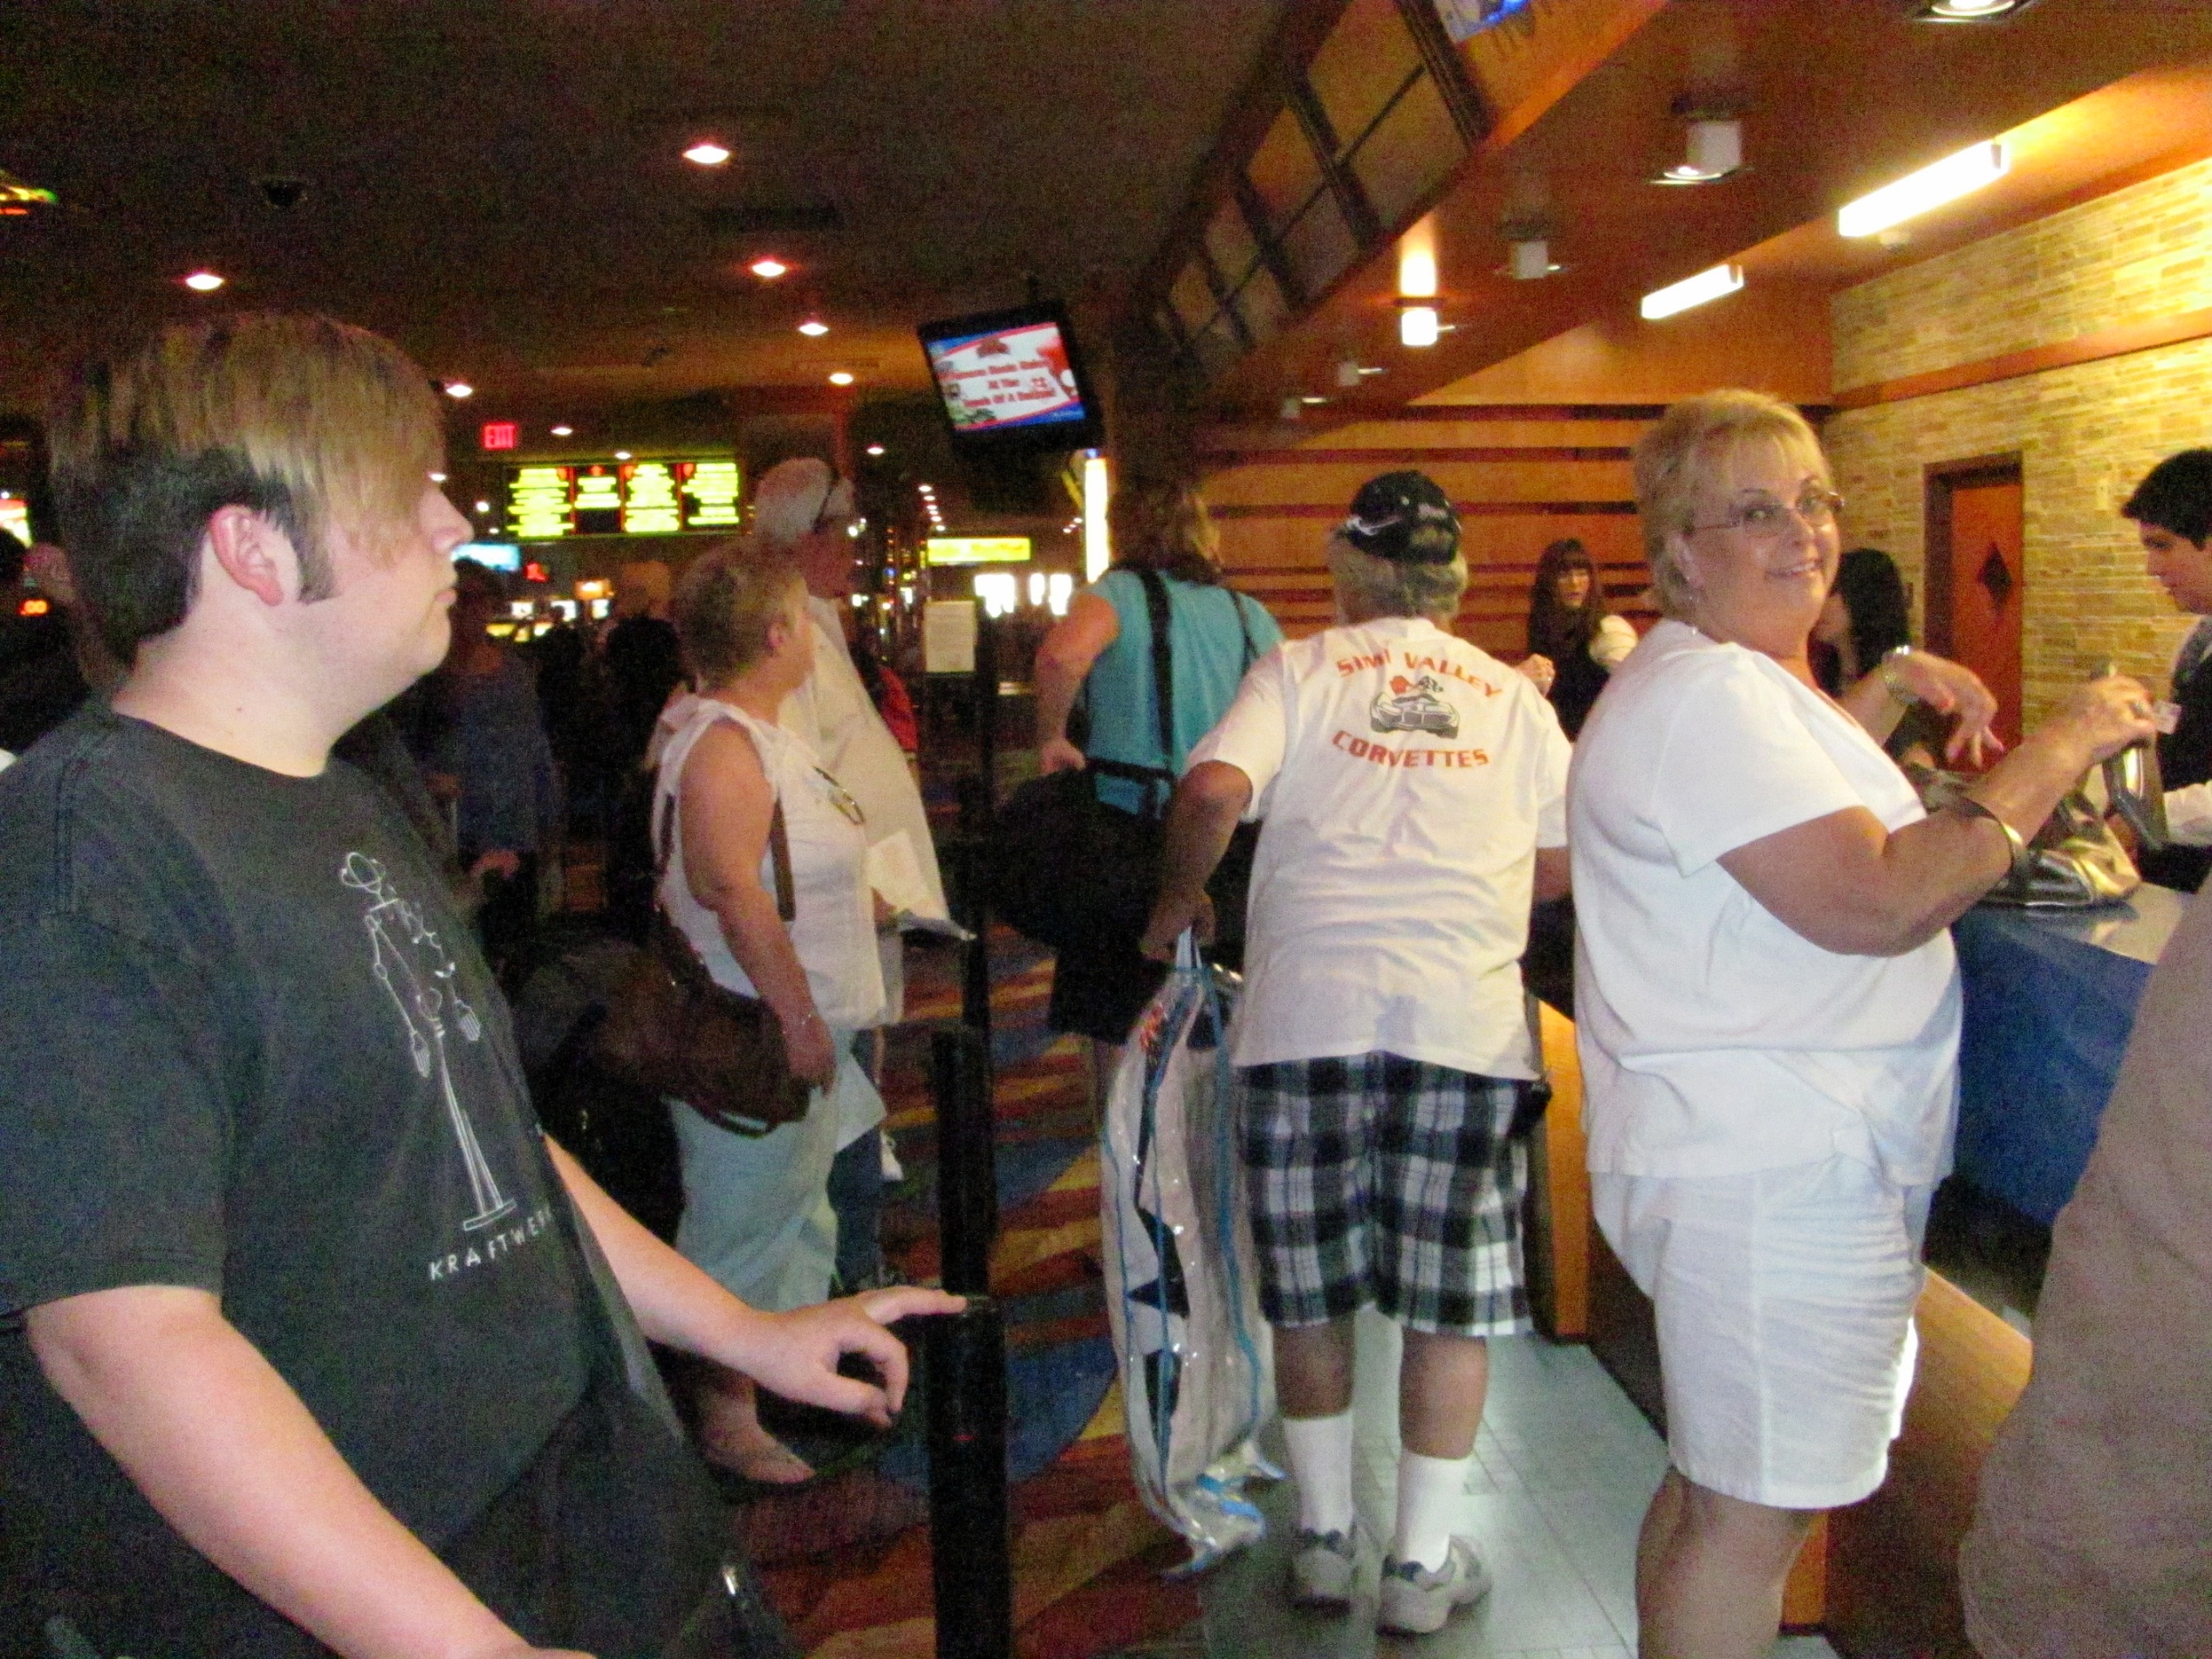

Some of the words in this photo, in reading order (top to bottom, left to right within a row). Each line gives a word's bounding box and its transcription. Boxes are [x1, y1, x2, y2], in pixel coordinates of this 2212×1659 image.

[484, 425, 515, 449] EXIT
[1336, 648, 1391, 678] SIMI
[1404, 652, 1503, 699] VALLEY
[1332, 730, 1490, 768] CORVETTES
